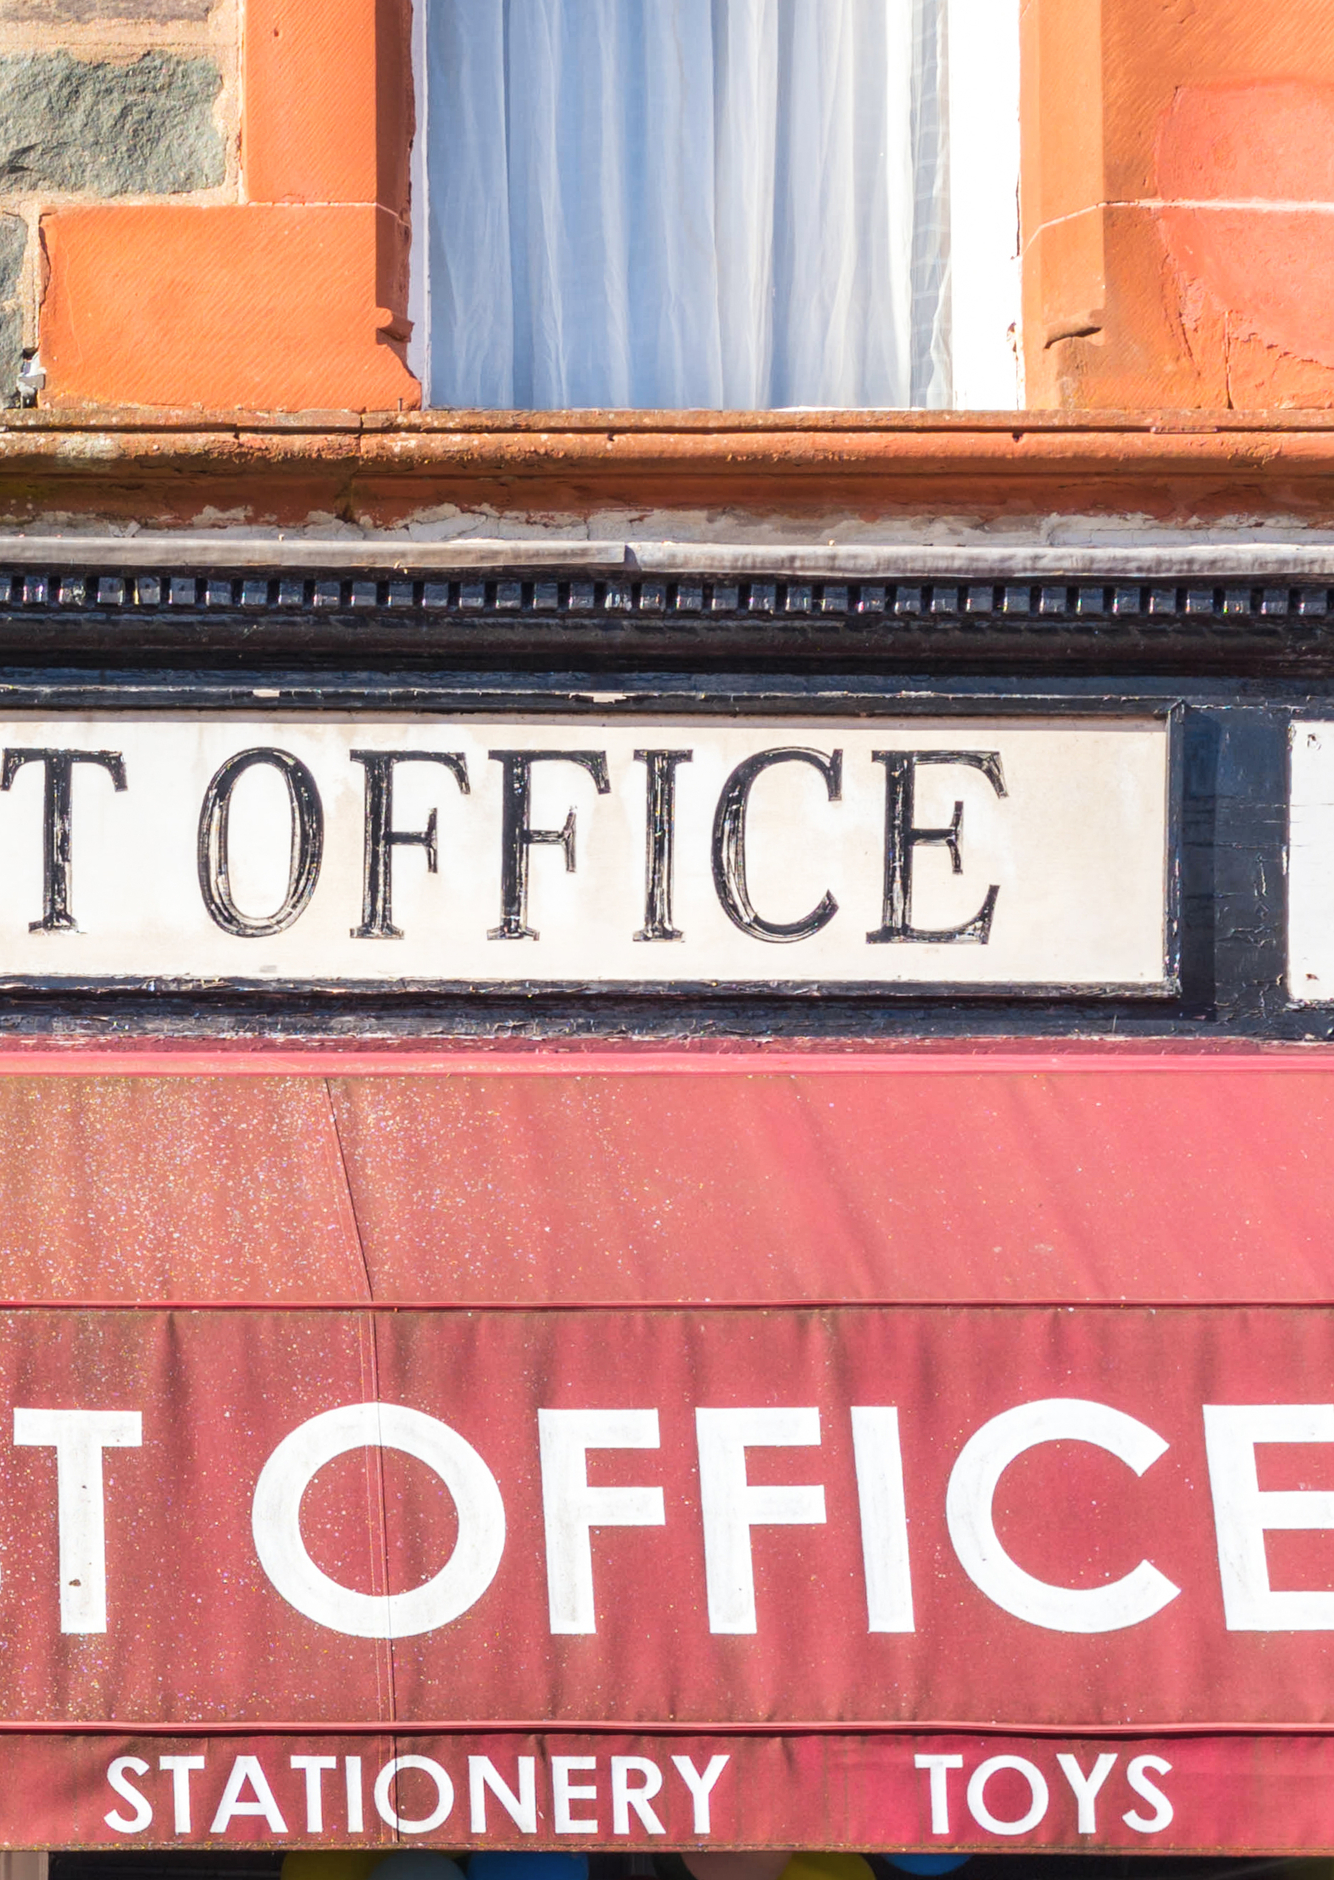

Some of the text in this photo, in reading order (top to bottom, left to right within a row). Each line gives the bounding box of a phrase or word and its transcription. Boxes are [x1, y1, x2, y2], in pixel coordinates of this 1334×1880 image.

[197, 745, 1010, 945] OFFICE
[104, 1752, 731, 1838] STATIONERY
[914, 1753, 1177, 1837] TOYS
